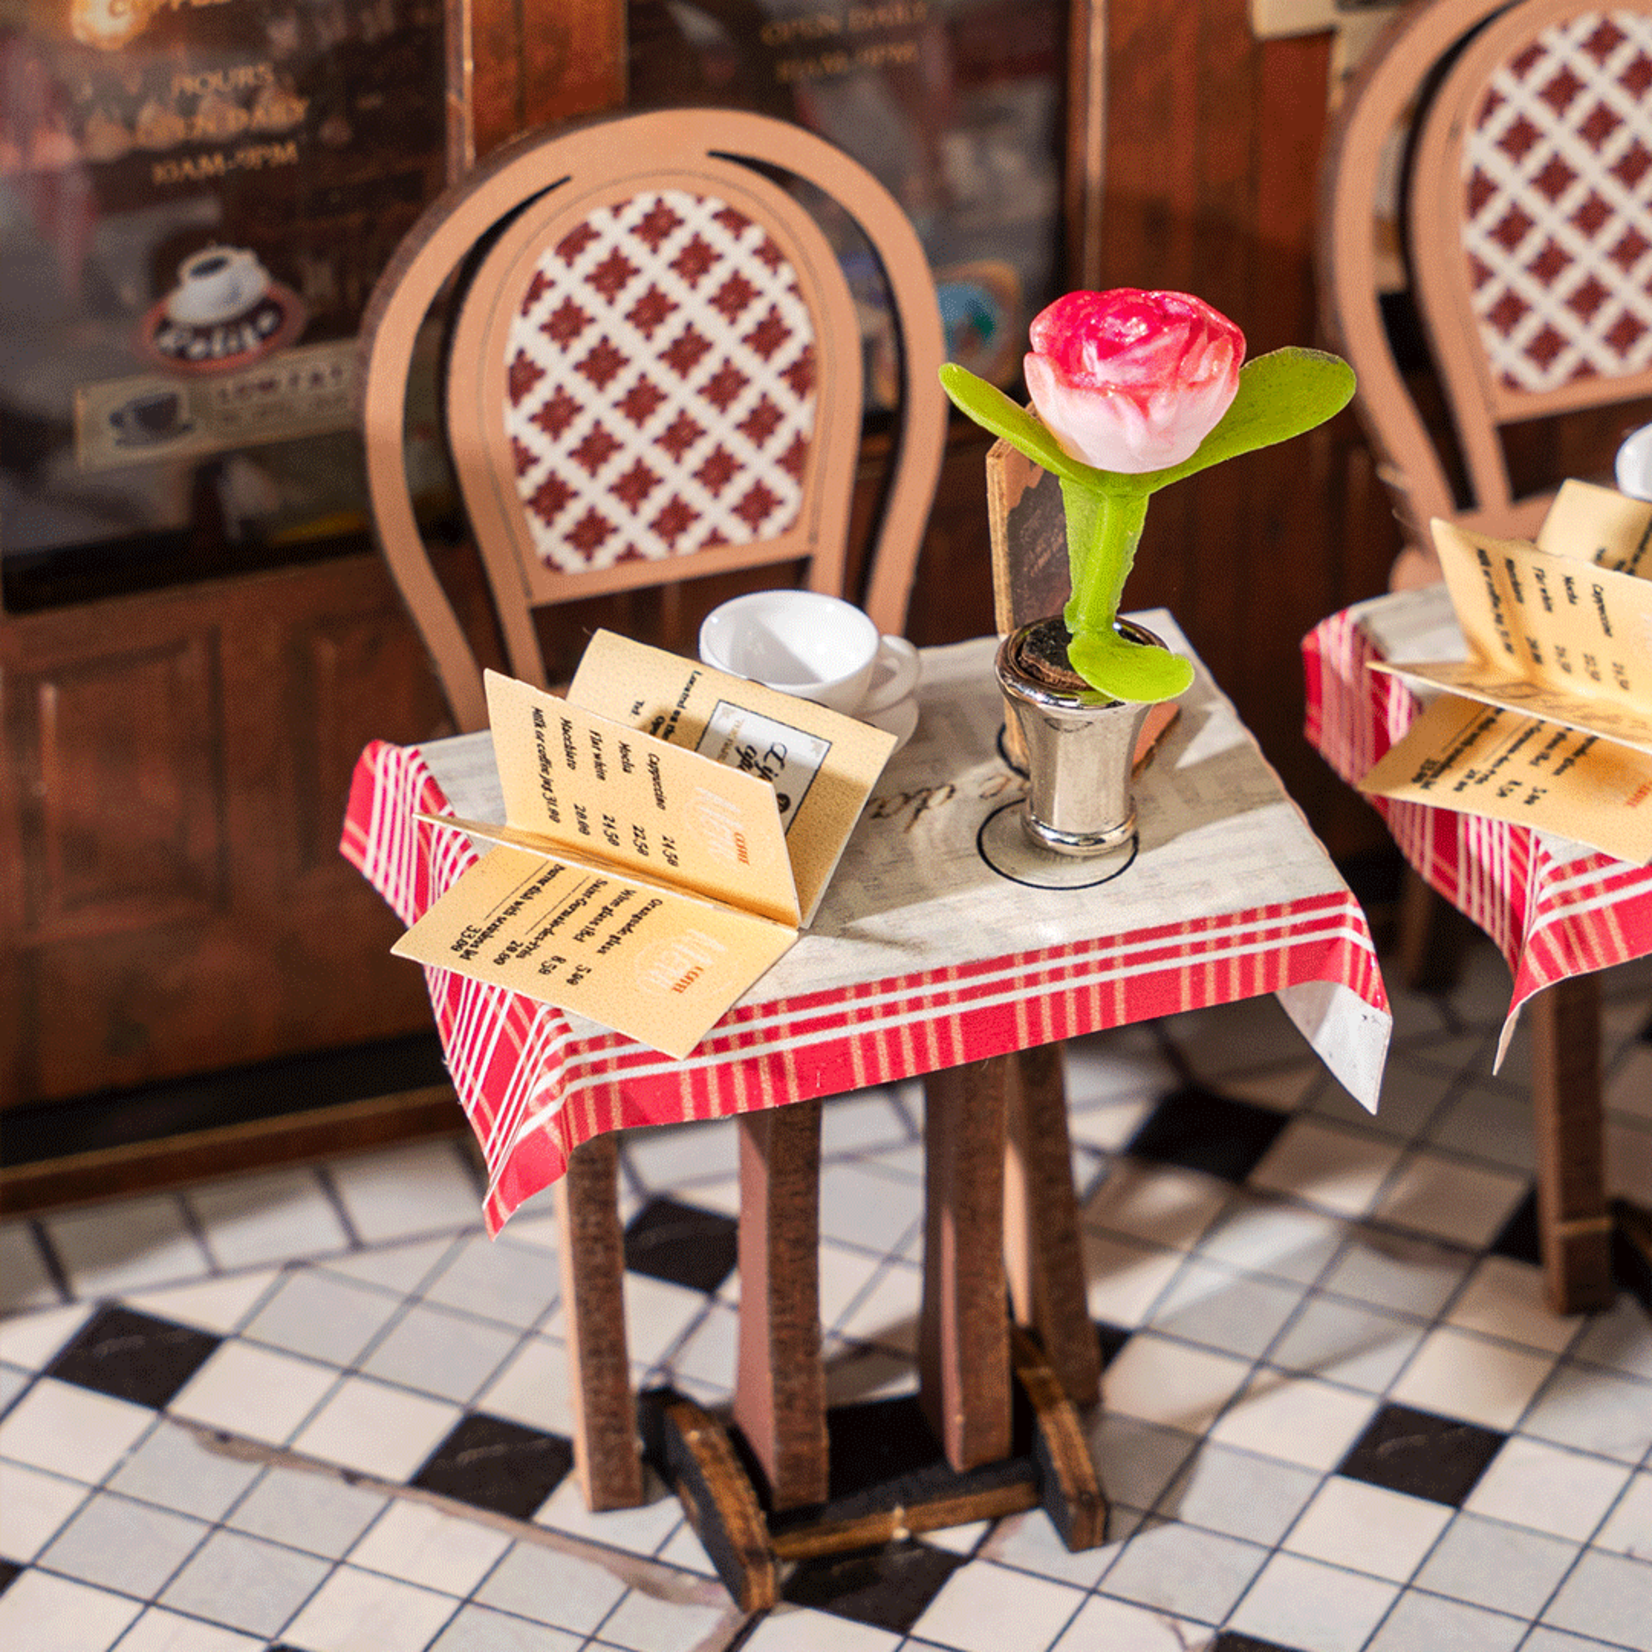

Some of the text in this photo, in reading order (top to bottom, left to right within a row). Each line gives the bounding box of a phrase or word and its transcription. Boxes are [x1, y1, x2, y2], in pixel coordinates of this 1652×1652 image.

[589, 729, 602, 754] Flat
[618, 740, 635, 774] Mocha
[648, 753, 667, 811] Cappuccino
